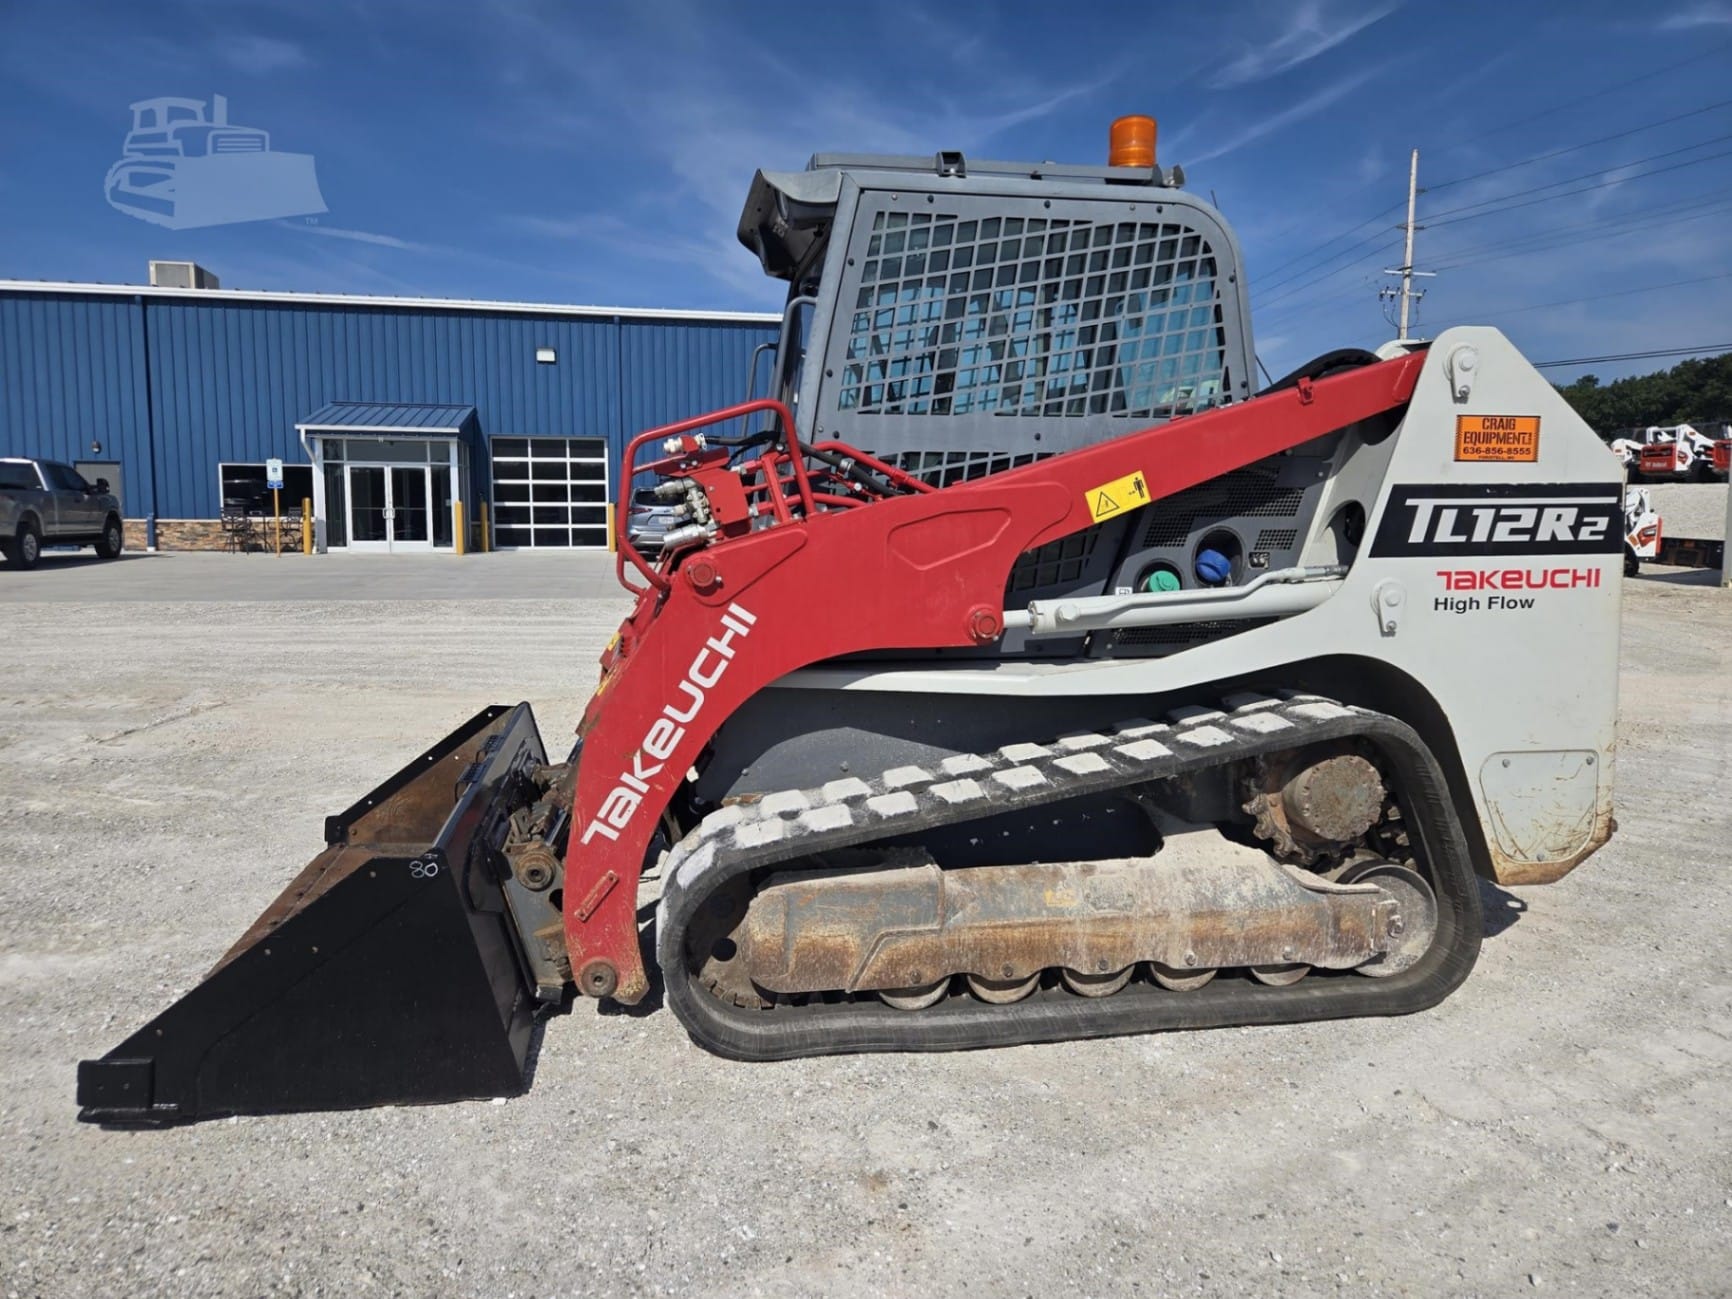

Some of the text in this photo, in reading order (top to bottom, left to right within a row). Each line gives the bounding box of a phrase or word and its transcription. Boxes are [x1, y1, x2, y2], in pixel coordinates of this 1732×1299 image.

[1482, 417, 1516, 430] CRAIG
[1464, 431, 1529, 445] EQUIPMENT
[1463, 446, 1531, 455] 636-856-8555
[1405, 497, 1618, 543] TL12R2
[1434, 596, 1535, 614] High Flow
